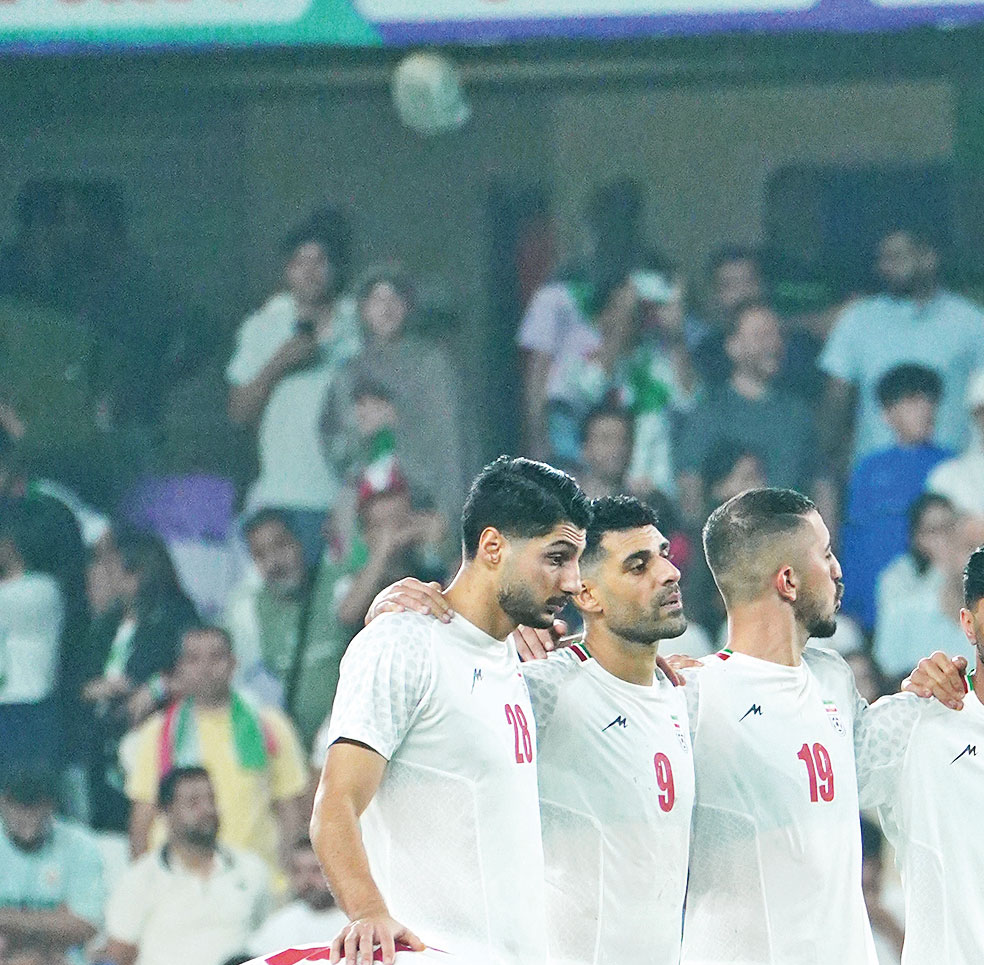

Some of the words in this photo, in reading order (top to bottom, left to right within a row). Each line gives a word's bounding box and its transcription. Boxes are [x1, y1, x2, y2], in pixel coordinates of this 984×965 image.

[505, 703, 533, 764] 28
[654, 752, 675, 812] 9
[797, 742, 835, 803] 19
